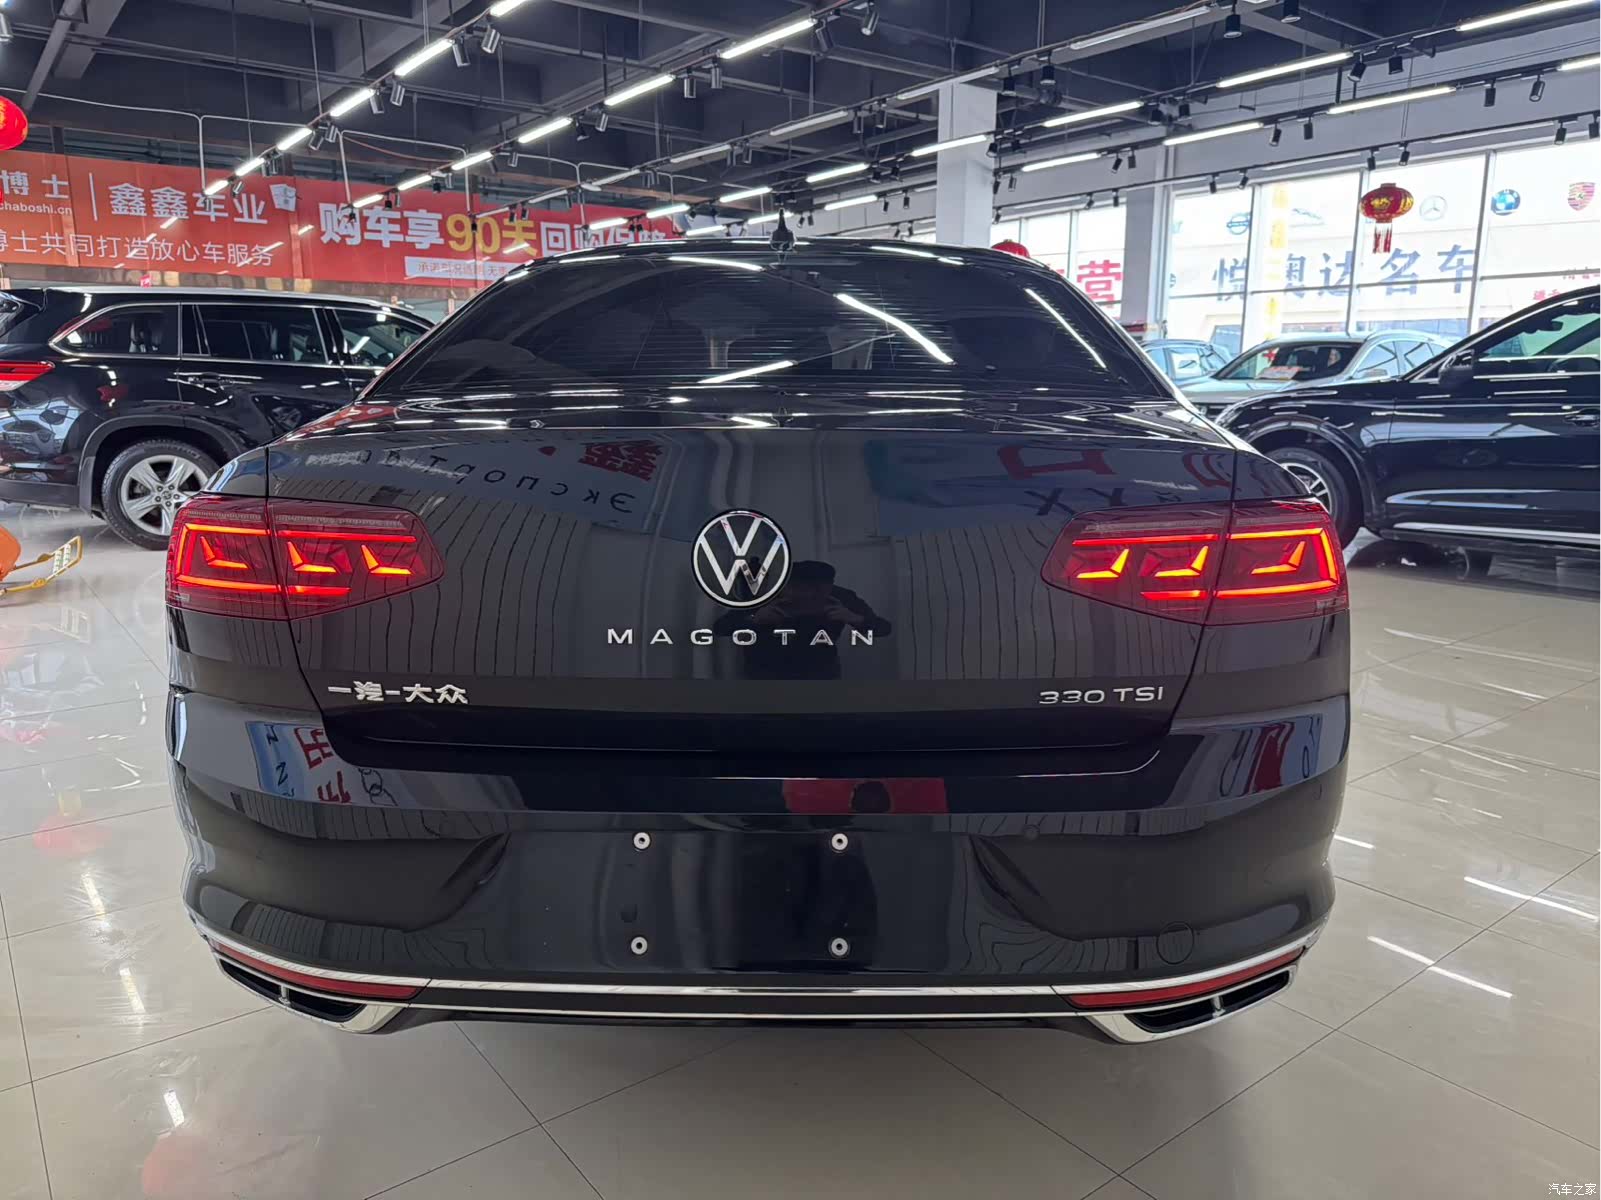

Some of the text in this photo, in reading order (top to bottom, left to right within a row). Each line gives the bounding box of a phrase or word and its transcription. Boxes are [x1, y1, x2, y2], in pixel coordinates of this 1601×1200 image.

[108, 183, 268, 225] 鑫鑫车业
[607, 628, 873, 646] MAGOTAN
[328, 681, 468, 704] 一汽-大众
[1039, 686, 1164, 704] 330 TSI
